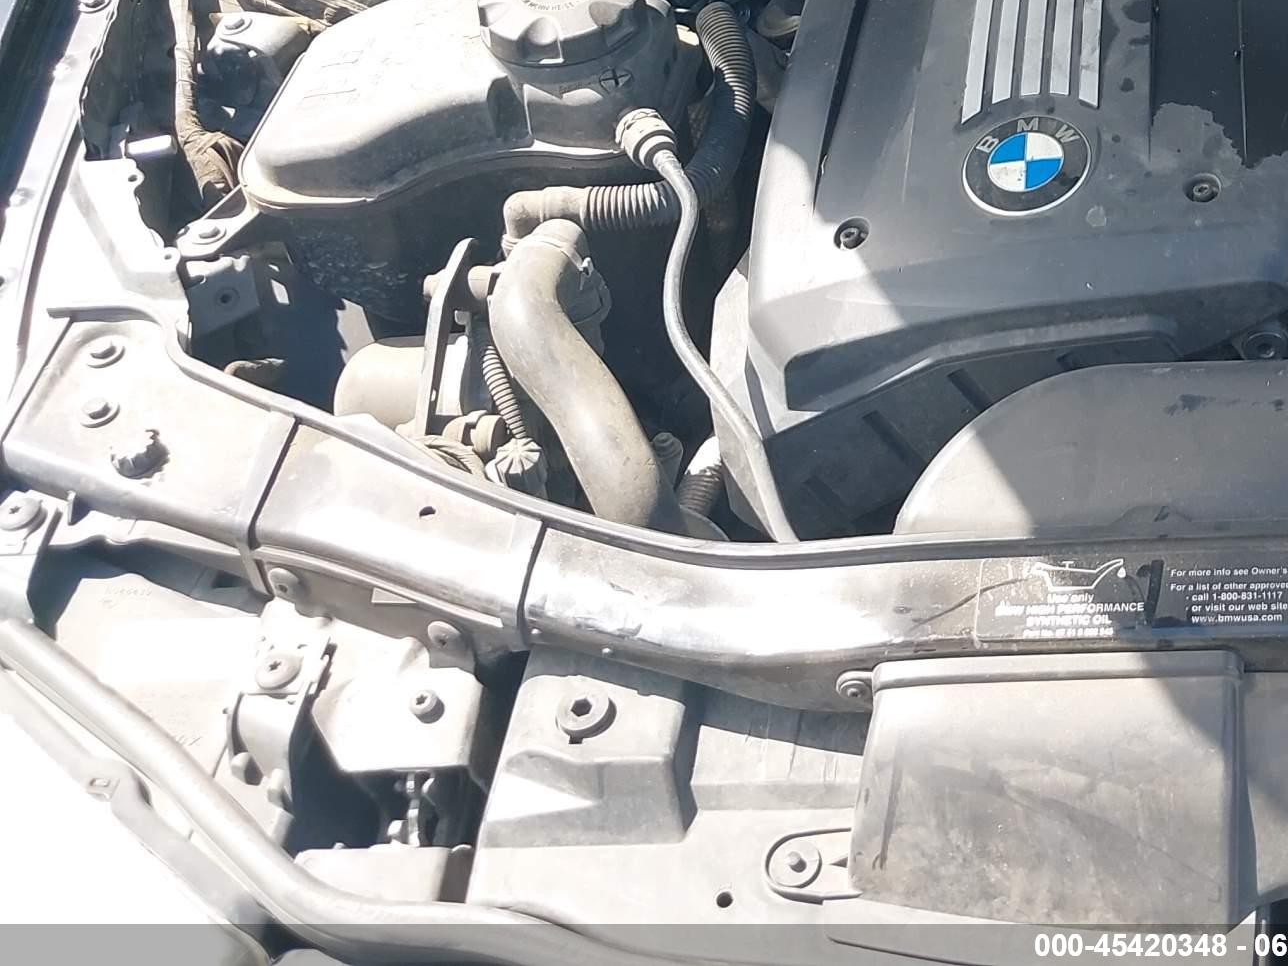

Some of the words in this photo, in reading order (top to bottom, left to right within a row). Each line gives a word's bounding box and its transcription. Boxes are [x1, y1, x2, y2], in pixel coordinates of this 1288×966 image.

[976, 117, 1081, 154] BMW
[1170, 569, 1187, 577] For
[1213, 567, 1231, 576] info
[1251, 567, 1288, 575] Owner's
[1170, 583, 1187, 591] For
[1196, 583, 1210, 591] list
[1212, 582, 1222, 590] of
[1223, 582, 1247, 590] other
[1047, 593, 1069, 603] Use
[1070, 592, 1095, 603] only
[1191, 592, 1209, 601] call
[1212, 591, 1283, 601] 1-800-831-1117
[1057, 602, 1145, 614] PERFORMANCE
[1191, 604, 1202, 612] or
[1205, 602, 1226, 611] visit
[1247, 602, 1267, 611] web
[1270, 602, 1288, 611] site
[1092, 614, 1112, 624] OIL
[1191, 613, 1283, 623] www.bmwusa.com
